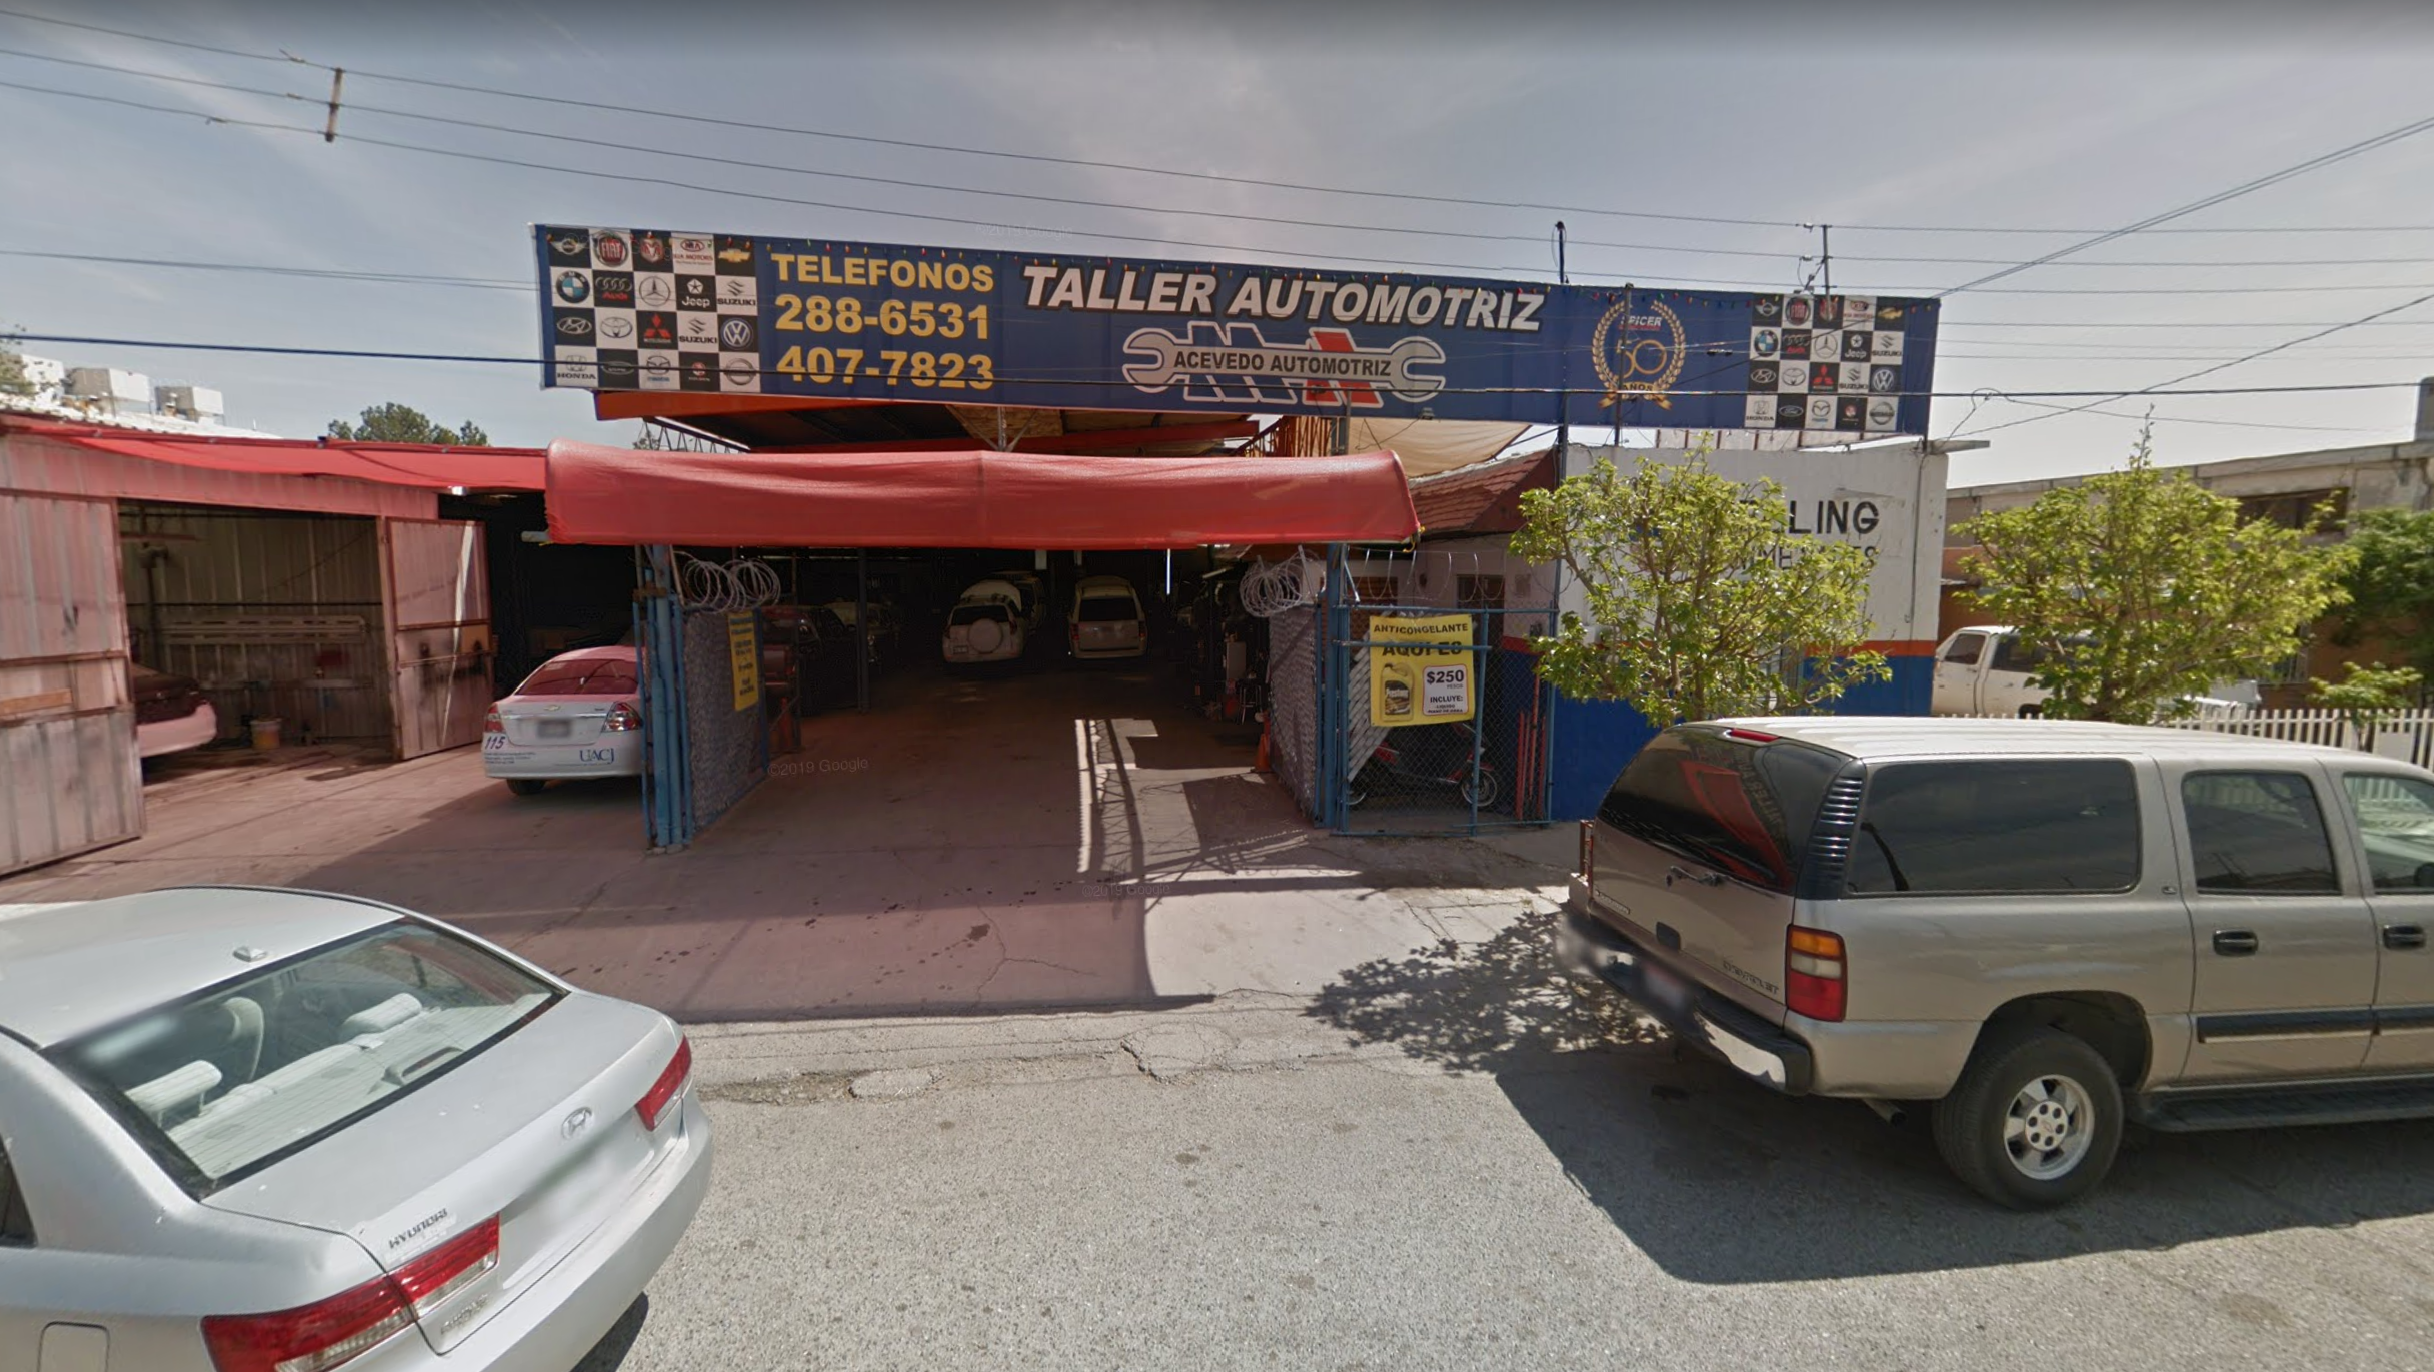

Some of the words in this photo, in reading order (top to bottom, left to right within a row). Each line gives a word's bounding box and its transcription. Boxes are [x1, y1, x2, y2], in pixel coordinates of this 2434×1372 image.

[771, 253, 994, 292] TELEFONOS
[681, 295, 710, 308] Jeep
[717, 297, 756, 306] SUZUKI
[1023, 266, 1217, 313] TALLER
[1227, 277, 1545, 331] AUTOMOTRIZ
[775, 294, 988, 339] 288-6531
[679, 335, 717, 344] SUZUKI
[776, 346, 994, 390] 407-7823
[1174, 351, 1264, 371] ACEVEDO
[1270, 357, 1391, 377] AUTOMOTRIZ
[1374, 623, 1468, 635] ANTICONGELANTE
[1427, 670, 1464, 685] $250
[1430, 695, 1463, 703] INCLUYE:
[486, 736, 506, 750] 115
[579, 748, 615, 764] UACJ
[389, 1208, 448, 1249] HYUNDAI
